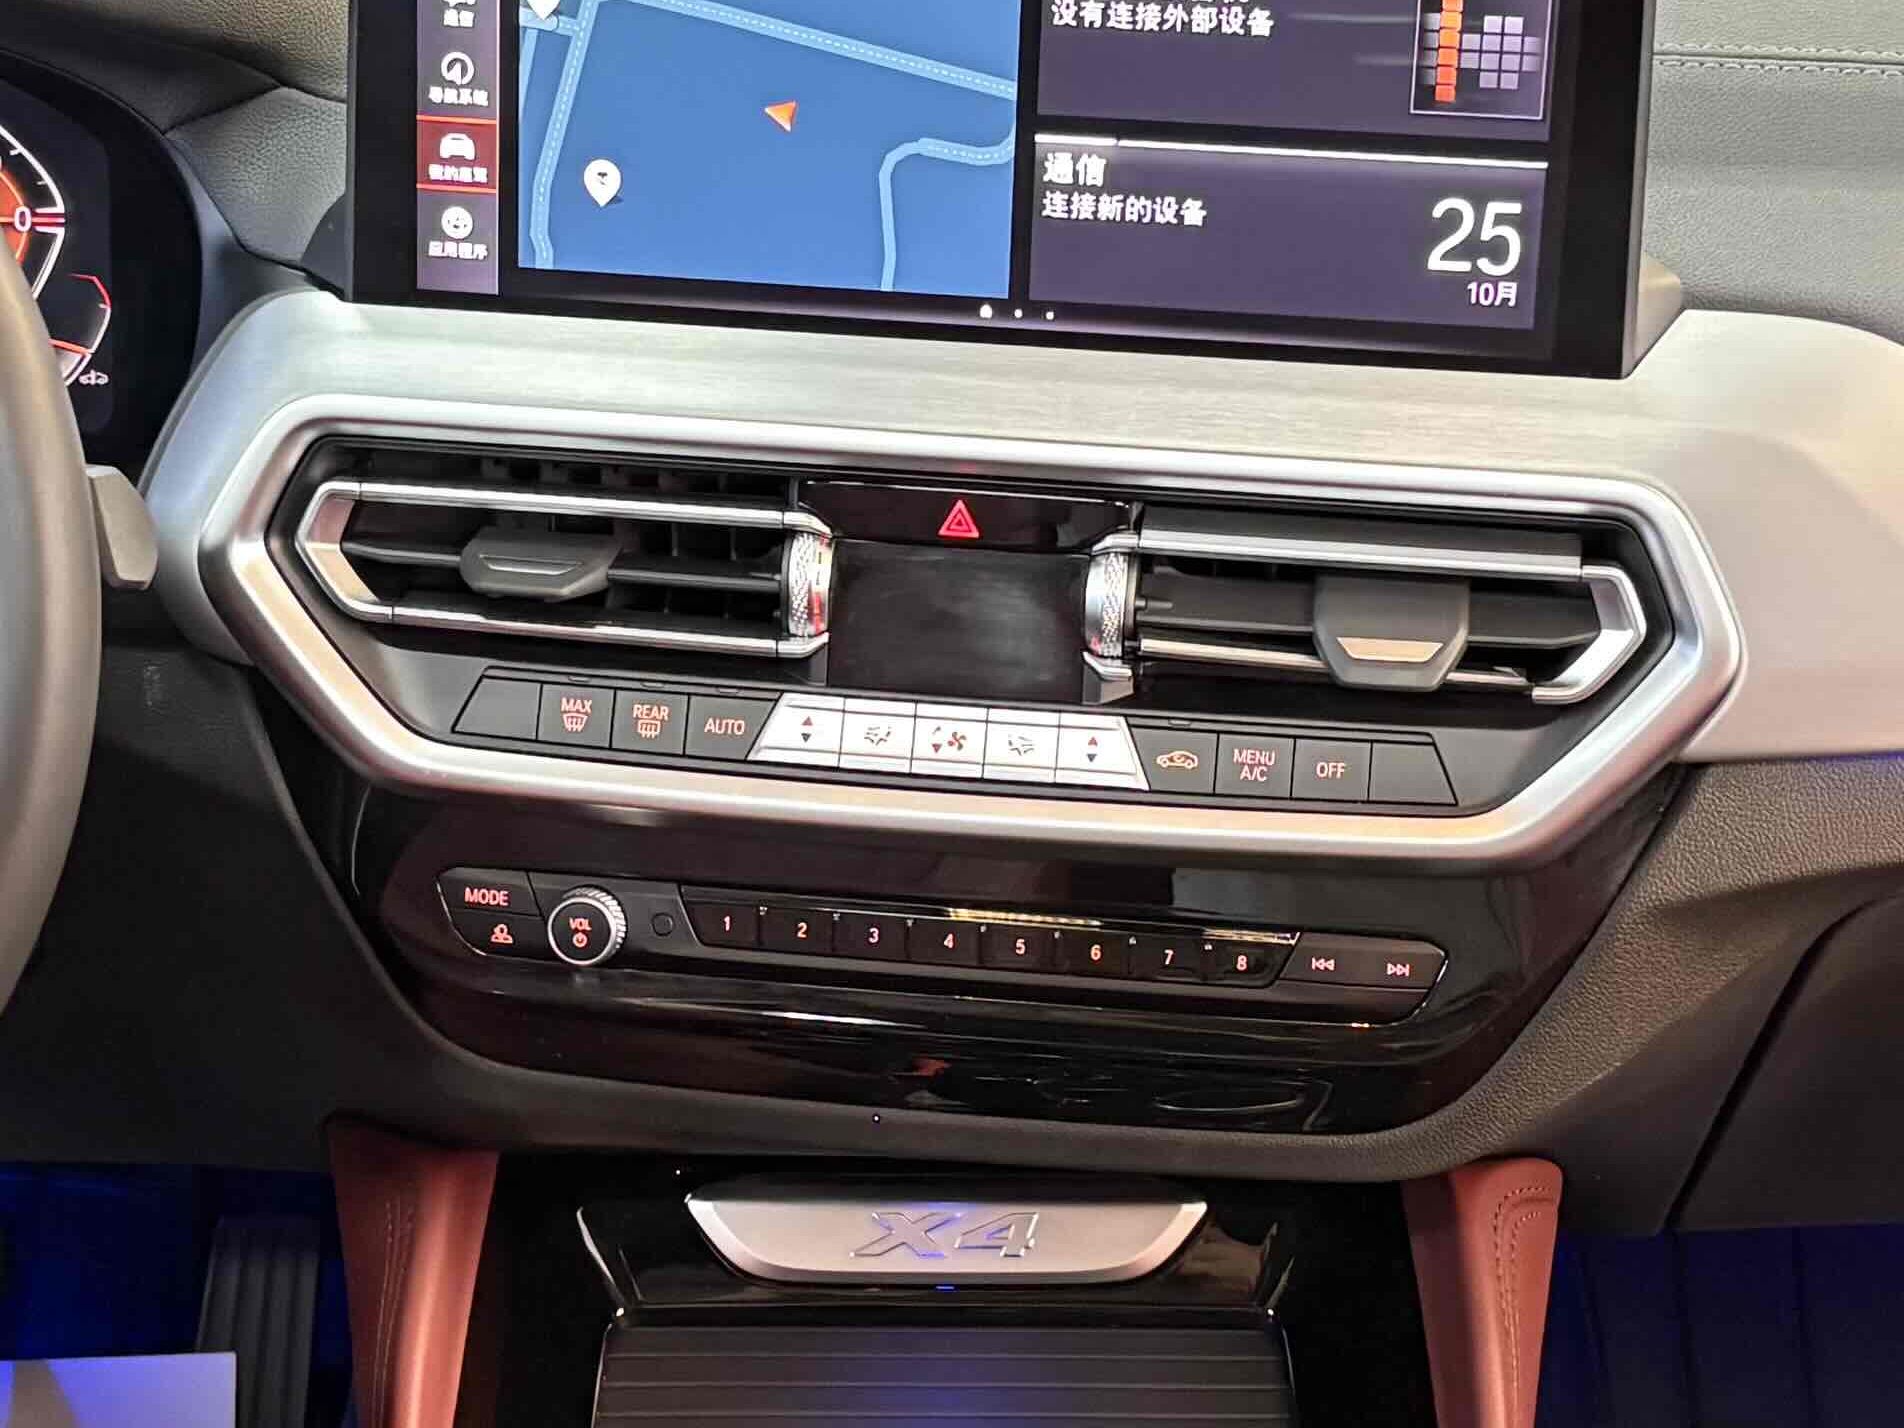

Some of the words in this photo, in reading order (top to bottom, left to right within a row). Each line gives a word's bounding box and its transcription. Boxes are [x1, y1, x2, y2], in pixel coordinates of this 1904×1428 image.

[1043, 152, 1107, 187] 通信
[1042, 190, 1207, 226] 连接新的设备
[14, 206, 32, 232] 0
[1427, 197, 1522, 277] 25
[1467, 281, 1518, 307] 10月
[561, 697, 592, 714] MAX
[633, 704, 669, 721] REAR
[704, 718, 745, 735] AUTO
[1233, 748, 1276, 767] MENU
[1240, 764, 1267, 781] A/C
[1316, 762, 1346, 778] OFF
[464, 887, 509, 907] MODE
[569, 917, 592, 931] VOL
[723, 916, 732, 931] 1
[797, 922, 808, 939] 2
[869, 927, 880, 943] 3
[943, 933, 954, 949] 4
[1015, 938, 1026, 955] 5
[1090, 944, 1102, 961] 6
[1164, 949, 1175, 966] 7
[1236, 954, 1248, 971] 8
[850, 1211, 1039, 1258] X4
